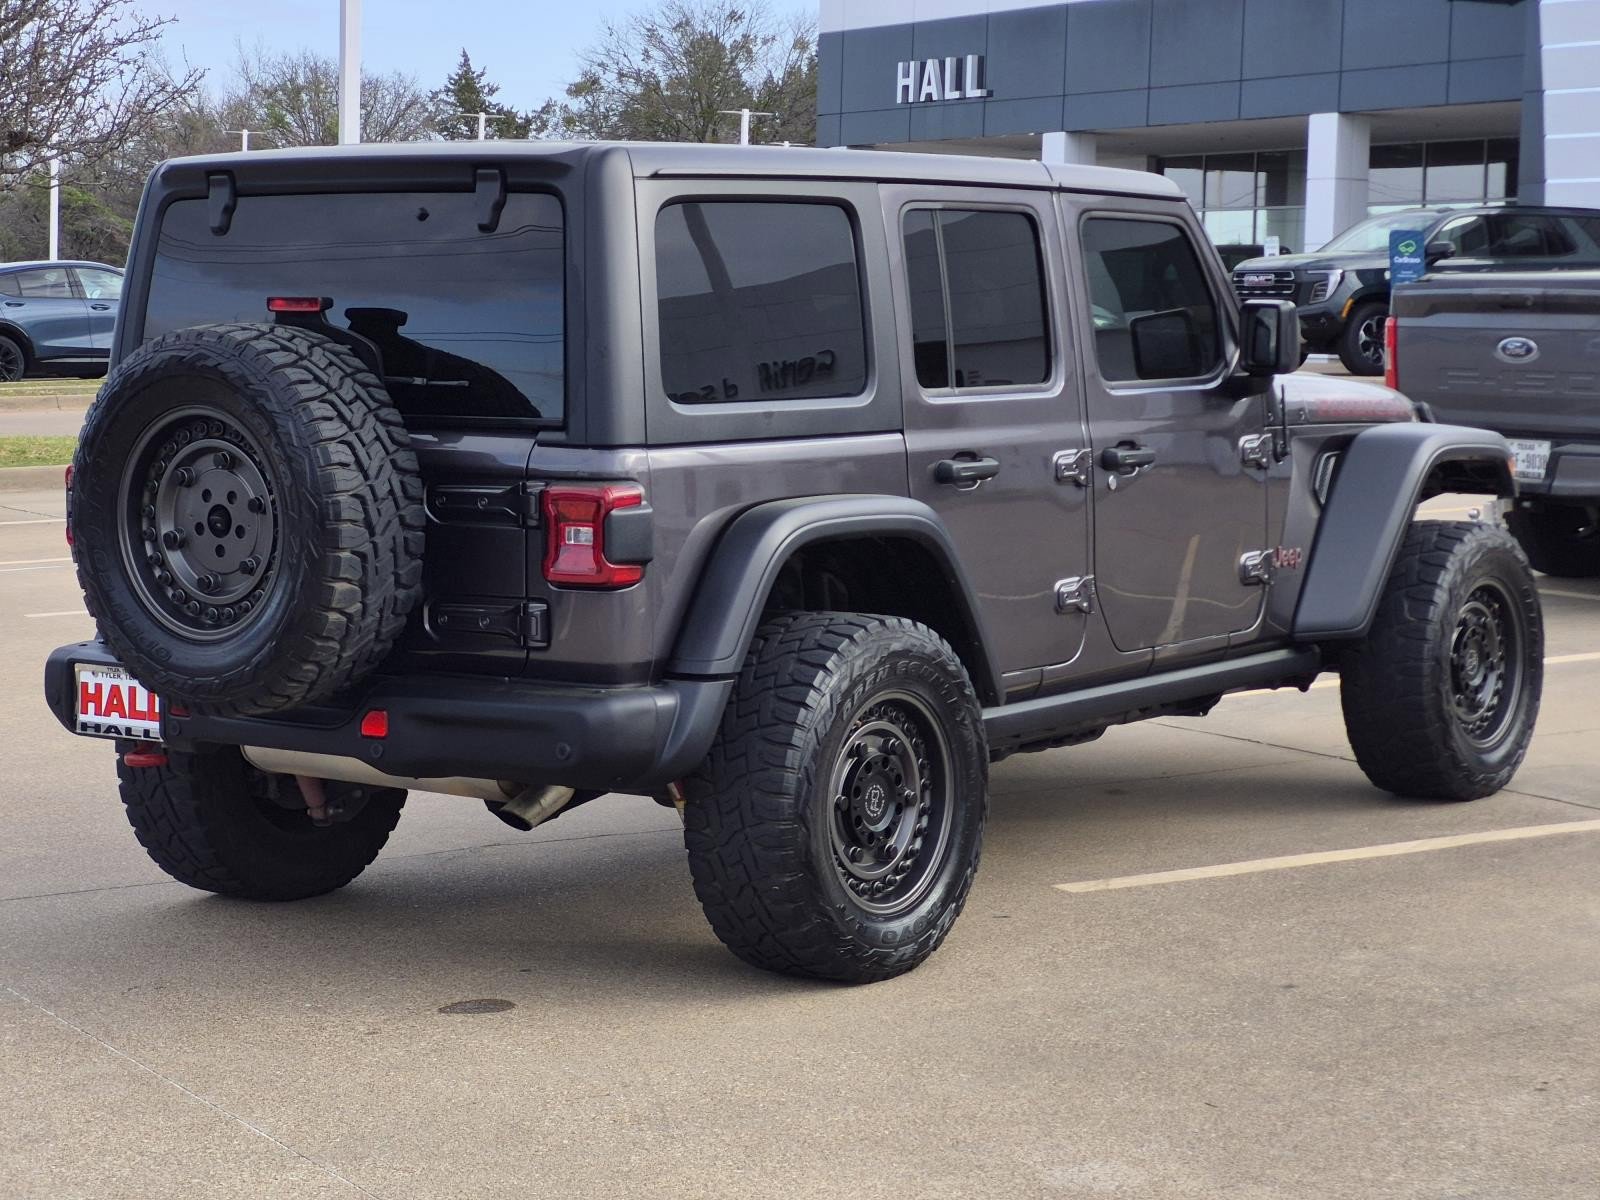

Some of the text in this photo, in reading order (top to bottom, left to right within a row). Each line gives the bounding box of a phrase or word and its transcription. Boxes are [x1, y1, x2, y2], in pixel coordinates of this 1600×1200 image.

[896, 54, 988, 104] HALL
[1272, 546, 1302, 569] Jeep
[80, 722, 161, 740] HALL
